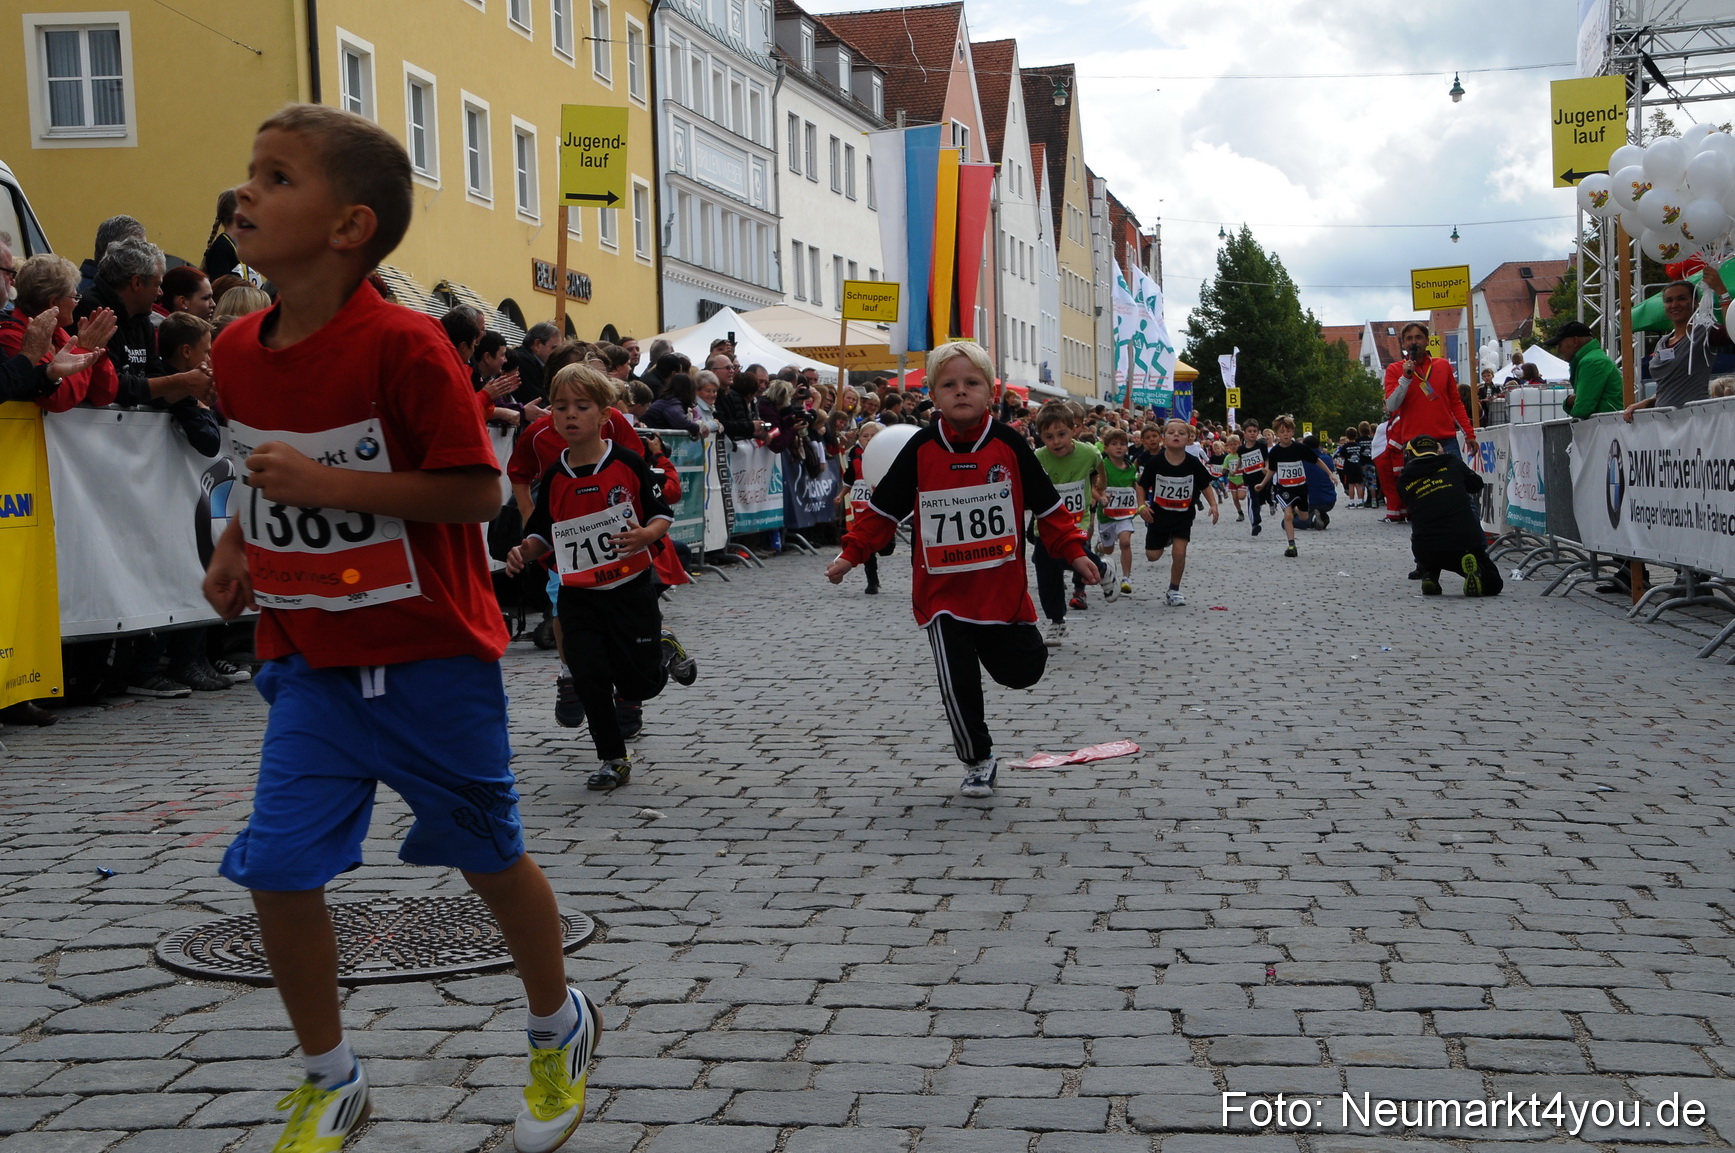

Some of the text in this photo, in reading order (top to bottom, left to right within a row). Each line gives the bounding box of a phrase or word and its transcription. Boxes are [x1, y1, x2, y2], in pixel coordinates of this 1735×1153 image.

[1554, 104, 1624, 128] Jugend-
[563, 131, 626, 154] Jugend-
[1573, 126, 1605, 144] lauf
[579, 152, 609, 169] lauf
[1414, 278, 1466, 291] Schnupper-
[846, 291, 895, 303] Schnupper-
[1432, 288, 1449, 299] lauf
[862, 303, 878, 312] lauf
[1230, 393, 1238, 404] B
[1243, 456, 1261, 467] 7253
[1628, 449, 1656, 488] BMW
[1281, 467, 1303, 479] 7390
[1431, 478, 1443, 486] Tag
[852, 488, 871, 501] 726
[921, 491, 997, 509] PARTL Neumarkt
[1159, 484, 1190, 500] 7245
[1065, 493, 1083, 512] 69
[1108, 495, 1135, 508] 7148
[1629, 499, 1659, 530] Weniger
[554, 514, 621, 539] PARTL Neumarkt
[930, 505, 1006, 544] 7186
[941, 544, 1003, 564] Johannes
[594, 565, 622, 584] Max
